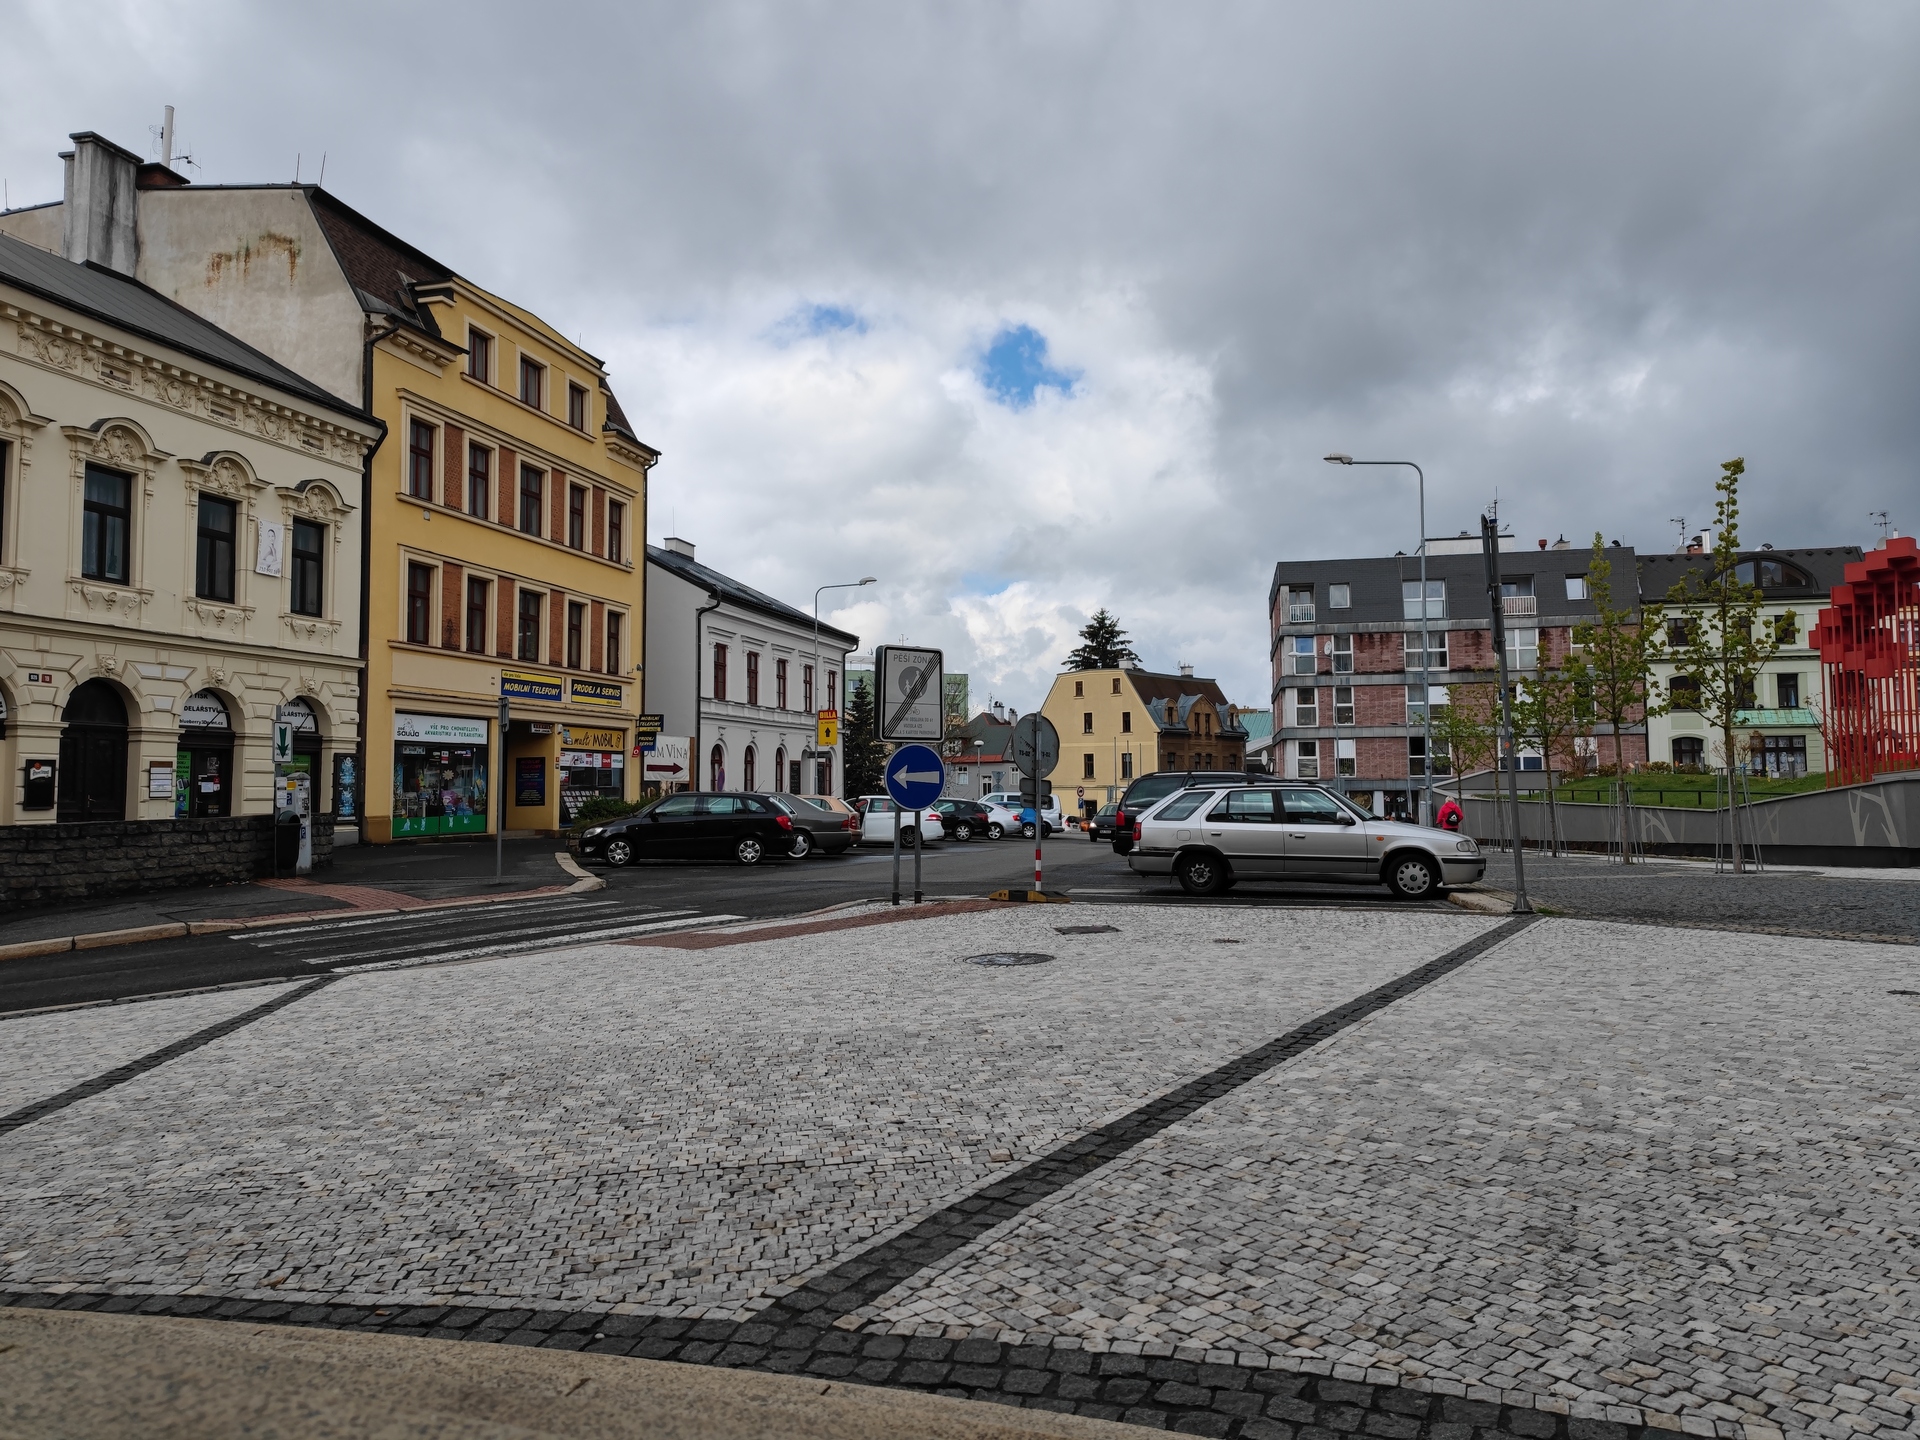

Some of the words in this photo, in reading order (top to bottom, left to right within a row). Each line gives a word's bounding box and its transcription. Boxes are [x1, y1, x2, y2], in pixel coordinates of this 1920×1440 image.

[893, 652, 911, 663] PĚŠÍ
[503, 682, 531, 693] MOBILNÍ
[531, 685, 560, 696] TELEFONY
[573, 683, 596, 694] PRODEJ
[595, 686, 601, 695] A
[601, 687, 621, 697] SERVIS
